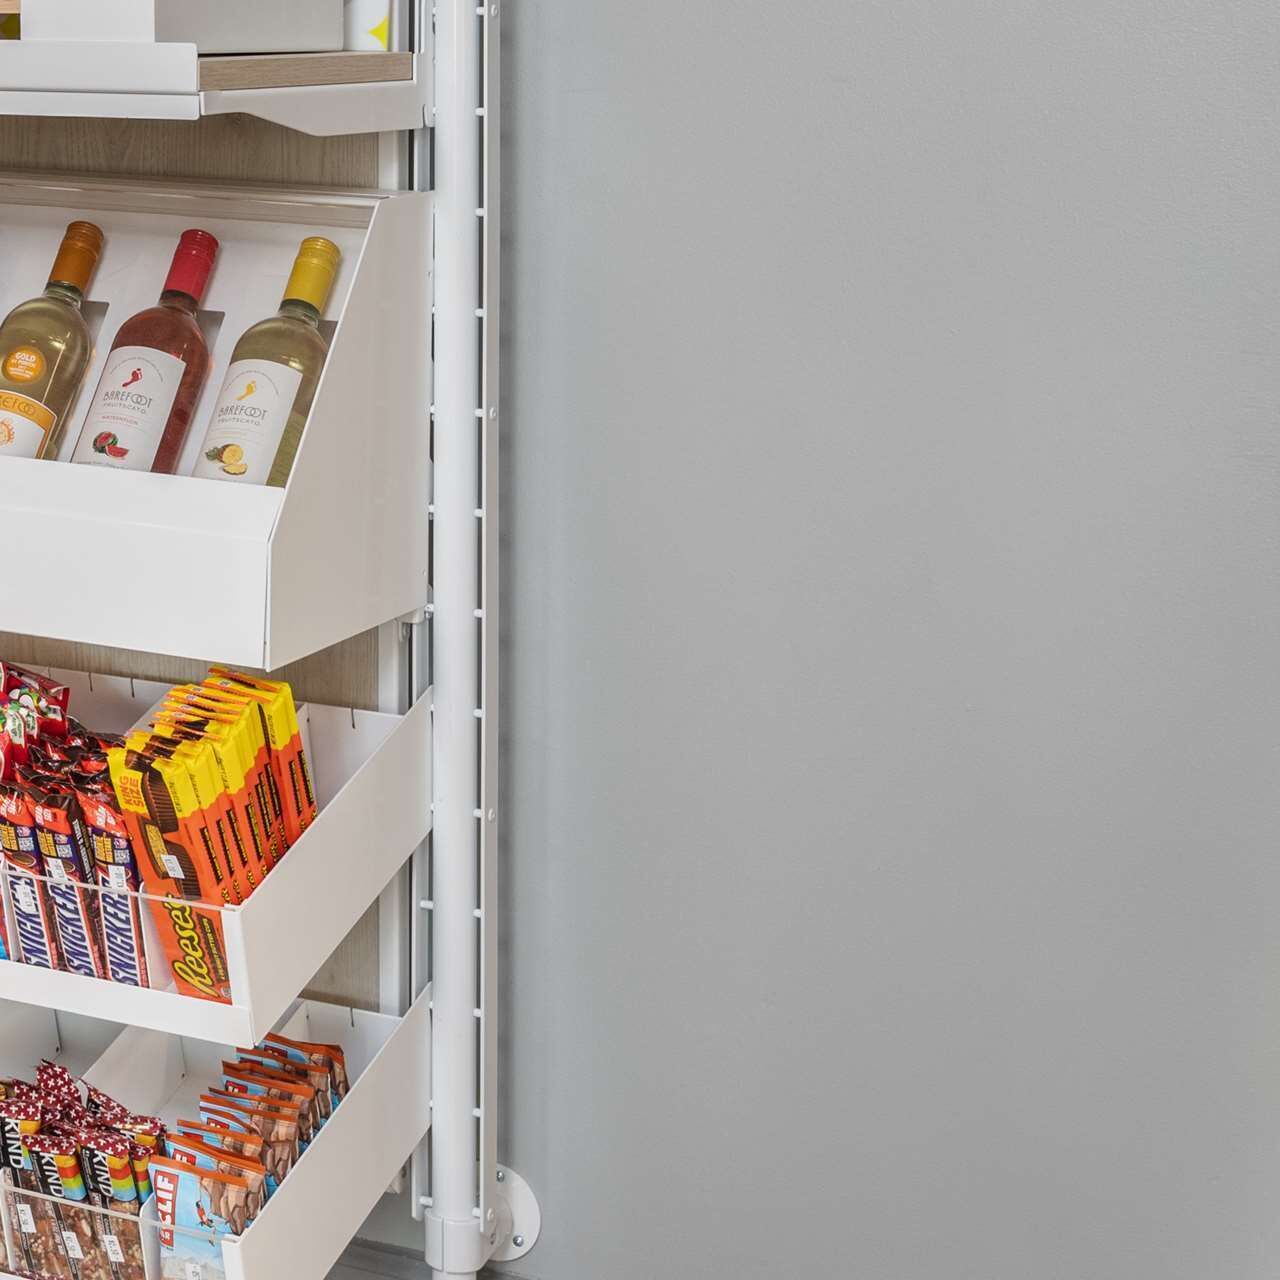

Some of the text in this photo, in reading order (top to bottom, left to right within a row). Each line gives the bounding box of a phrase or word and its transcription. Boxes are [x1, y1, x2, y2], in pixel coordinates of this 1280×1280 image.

[15, 352, 36, 362] GOLD
[103, 391, 153, 407] BAREFOOT
[217, 405, 267, 420] BAREFOOT
[119, 776, 134, 806] KING
[130, 776, 145, 807] SIZE
[5, 1118, 24, 1169] KIND
[40, 1152, 65, 1197] KIND
[92, 1151, 114, 1197] KIND
[156, 1174, 176, 1226] CLIF
